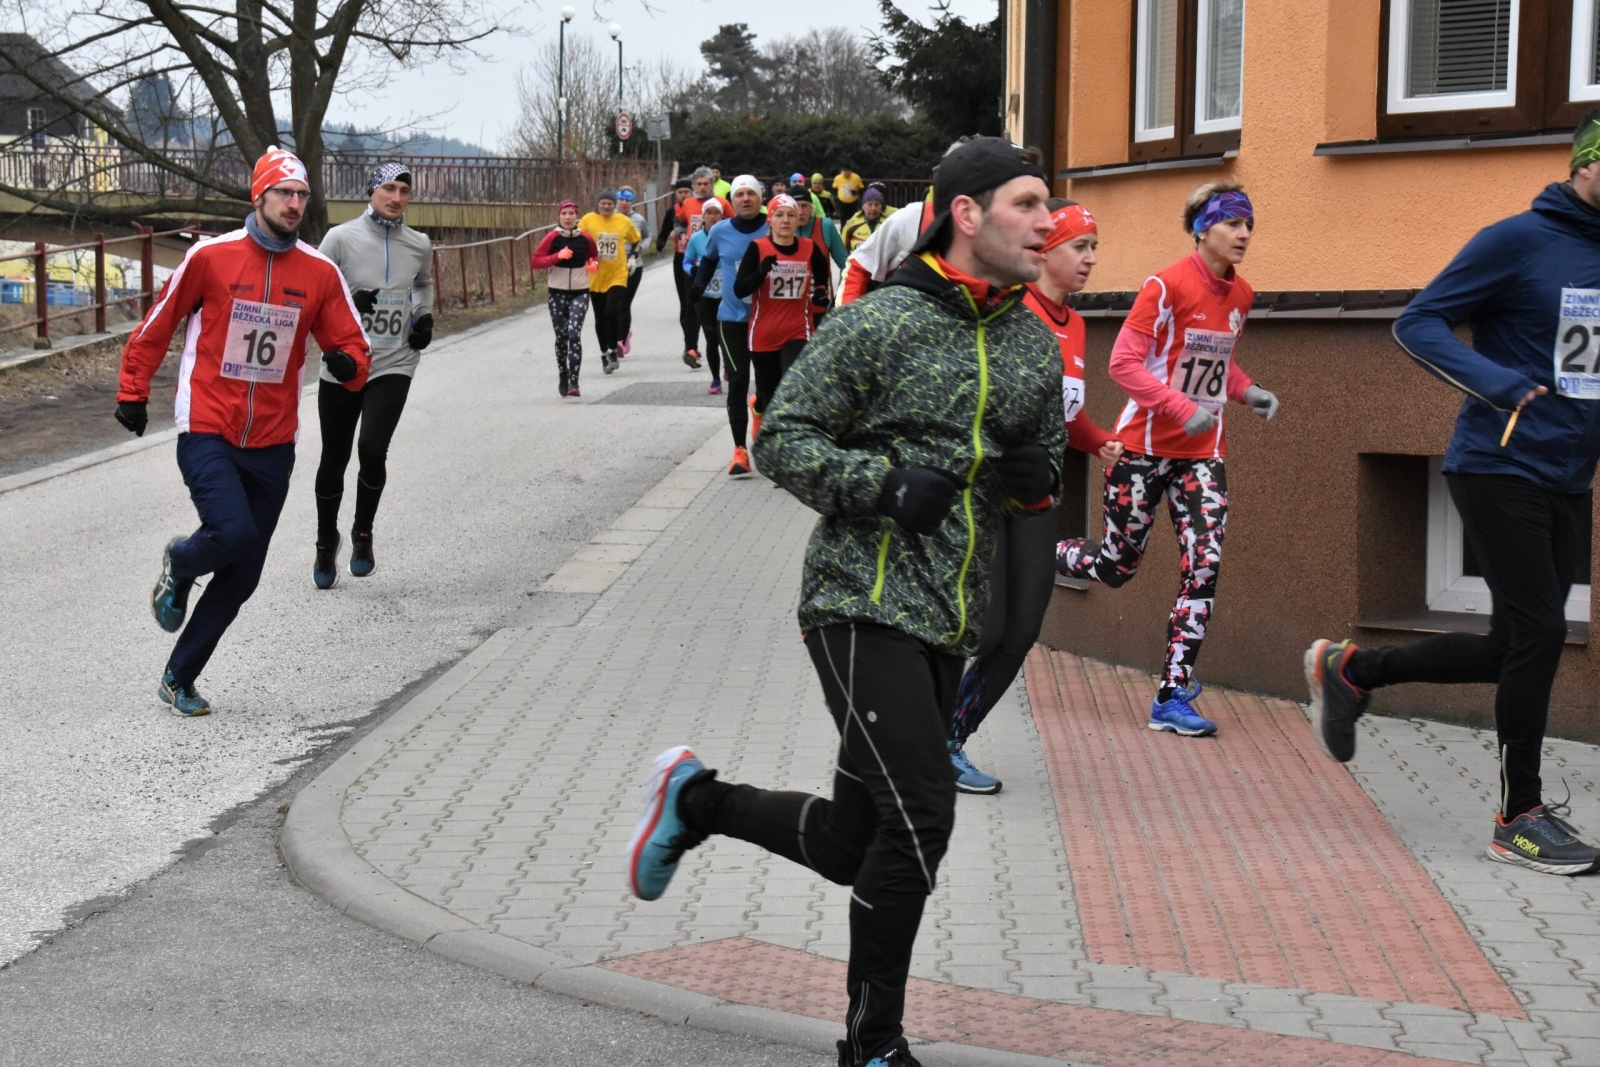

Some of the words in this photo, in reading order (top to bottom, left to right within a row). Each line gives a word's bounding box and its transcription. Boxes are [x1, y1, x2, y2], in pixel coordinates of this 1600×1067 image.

[773, 276, 805, 297] 217
[1565, 294, 1600, 304] ZIMNÍ
[234, 302, 262, 314] ZIMNÍ
[232, 311, 271, 325] BĚŽECKÁ
[275, 318, 294, 328] LIGA
[1187, 332, 1212, 343] ZIMNÍ
[243, 329, 277, 366] 16
[1185, 342, 1218, 354] BĚŽECKÁ
[1181, 356, 1225, 397] 178
[1512, 833, 1540, 857] HOKA
